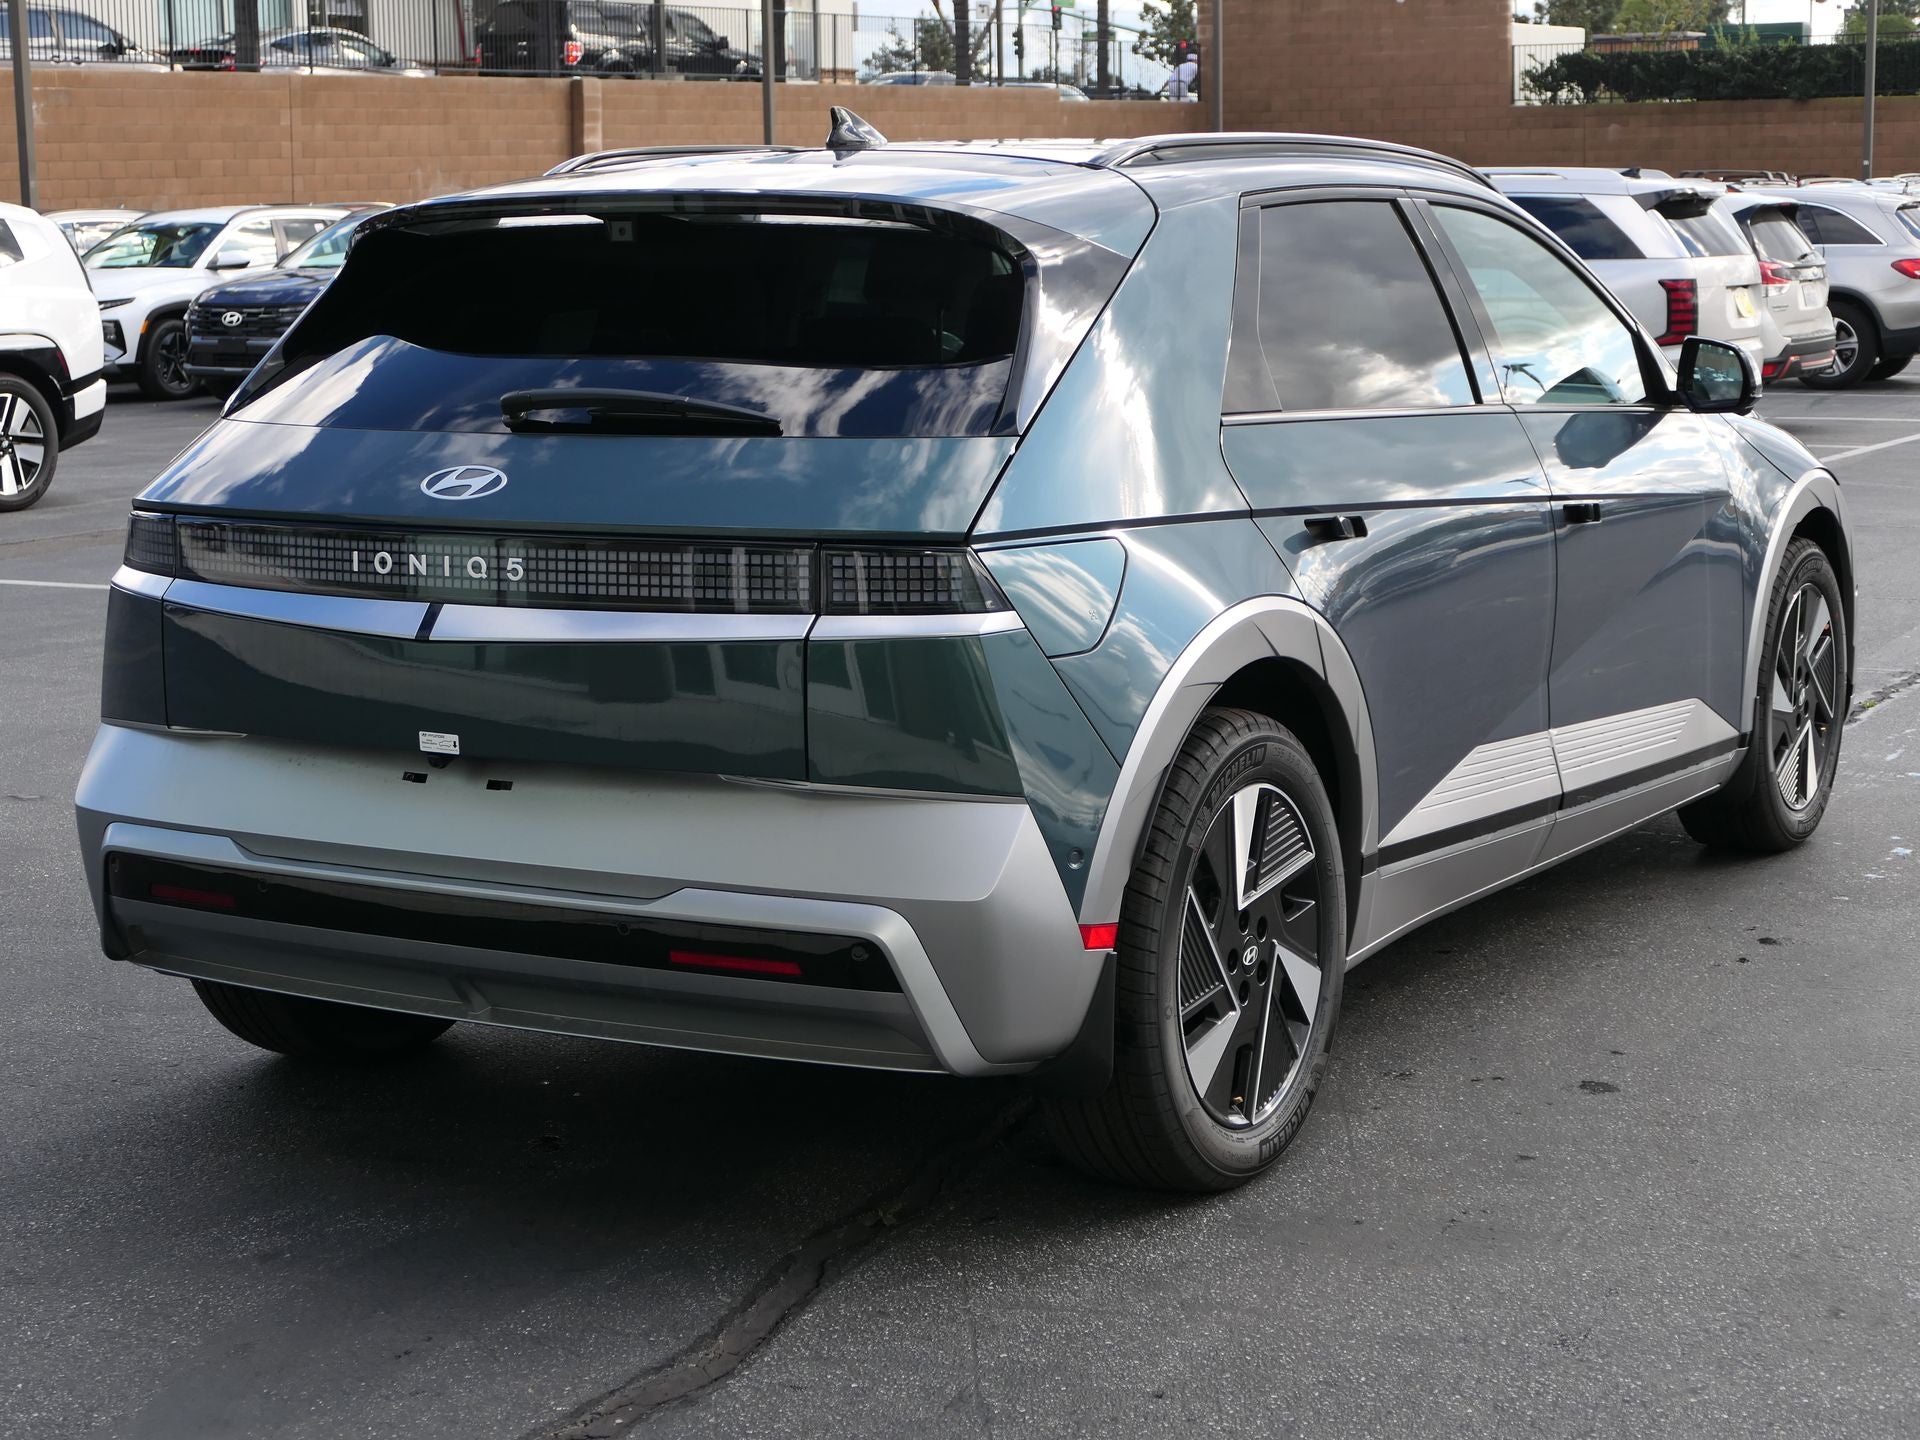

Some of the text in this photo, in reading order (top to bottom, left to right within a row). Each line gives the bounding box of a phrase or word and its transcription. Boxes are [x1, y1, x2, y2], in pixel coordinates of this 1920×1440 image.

[352, 550, 525, 582] IONIQ 5
[1211, 747, 1266, 807] MICHELIN
[1261, 1091, 1310, 1162] MICHELIN
